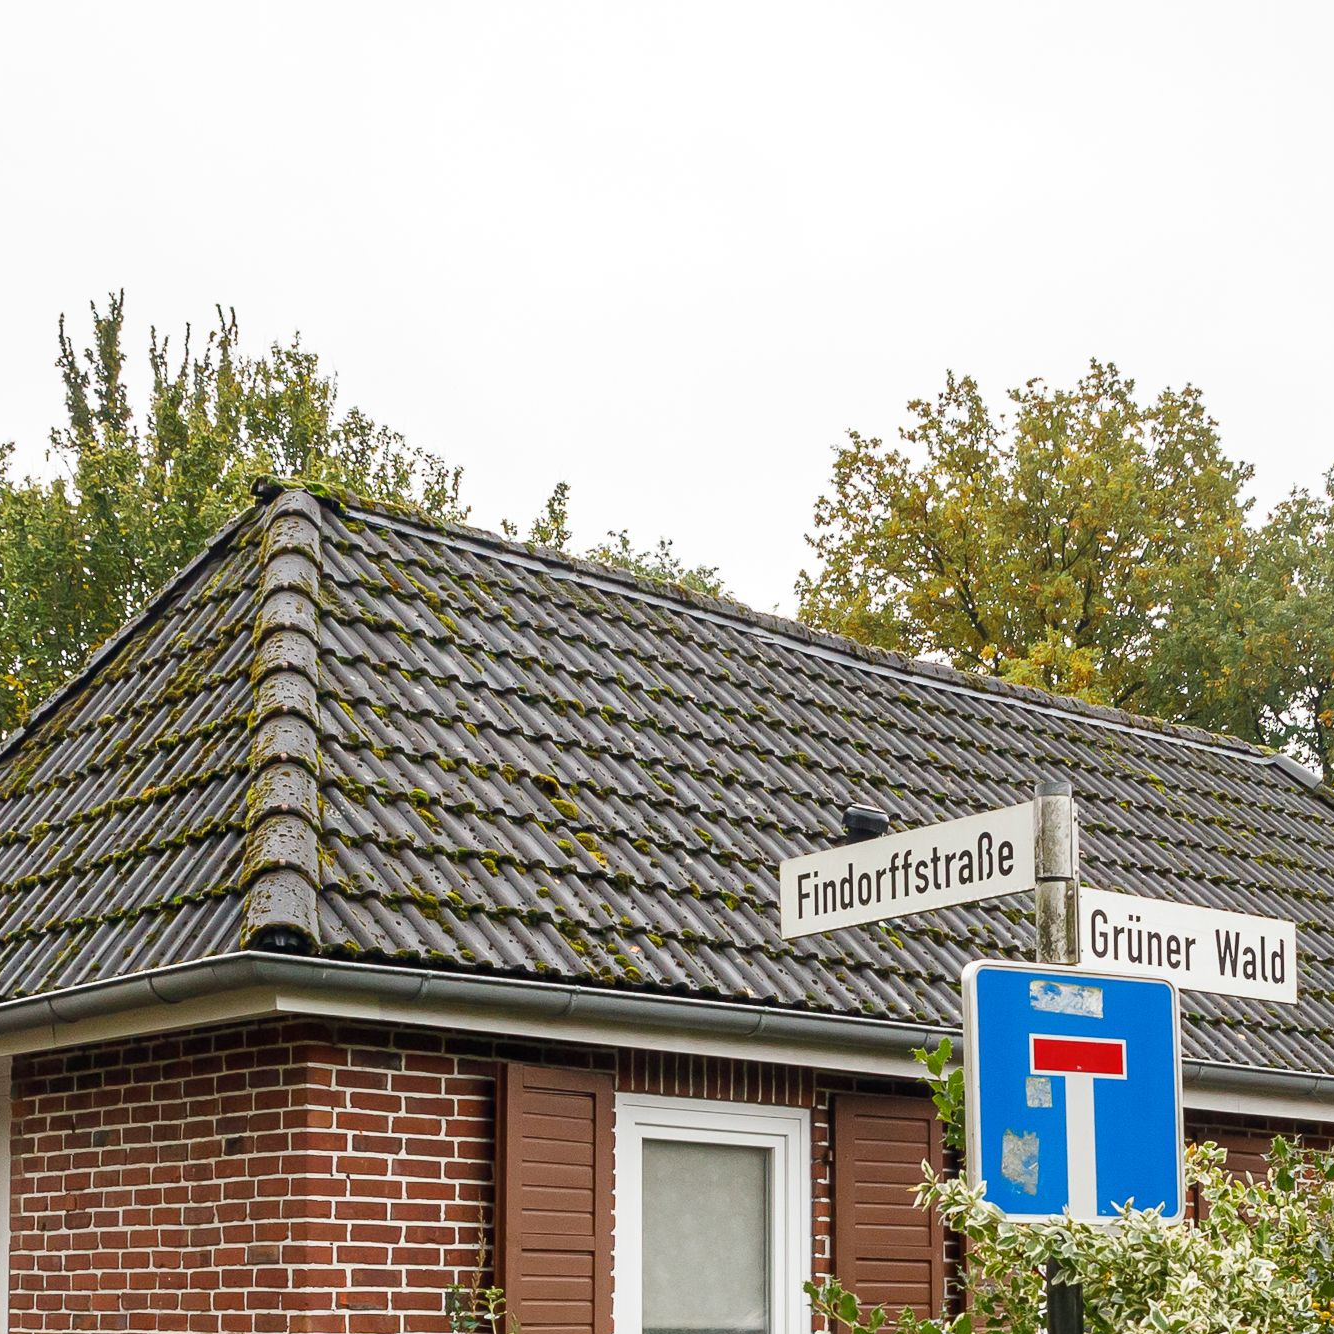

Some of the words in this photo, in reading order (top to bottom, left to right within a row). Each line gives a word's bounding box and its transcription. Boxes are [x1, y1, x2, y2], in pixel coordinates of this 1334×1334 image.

[797, 831, 1015, 919] Findorffstraße
[1090, 909, 1196, 971] Grüner
[1215, 929, 1285, 984] Wald
